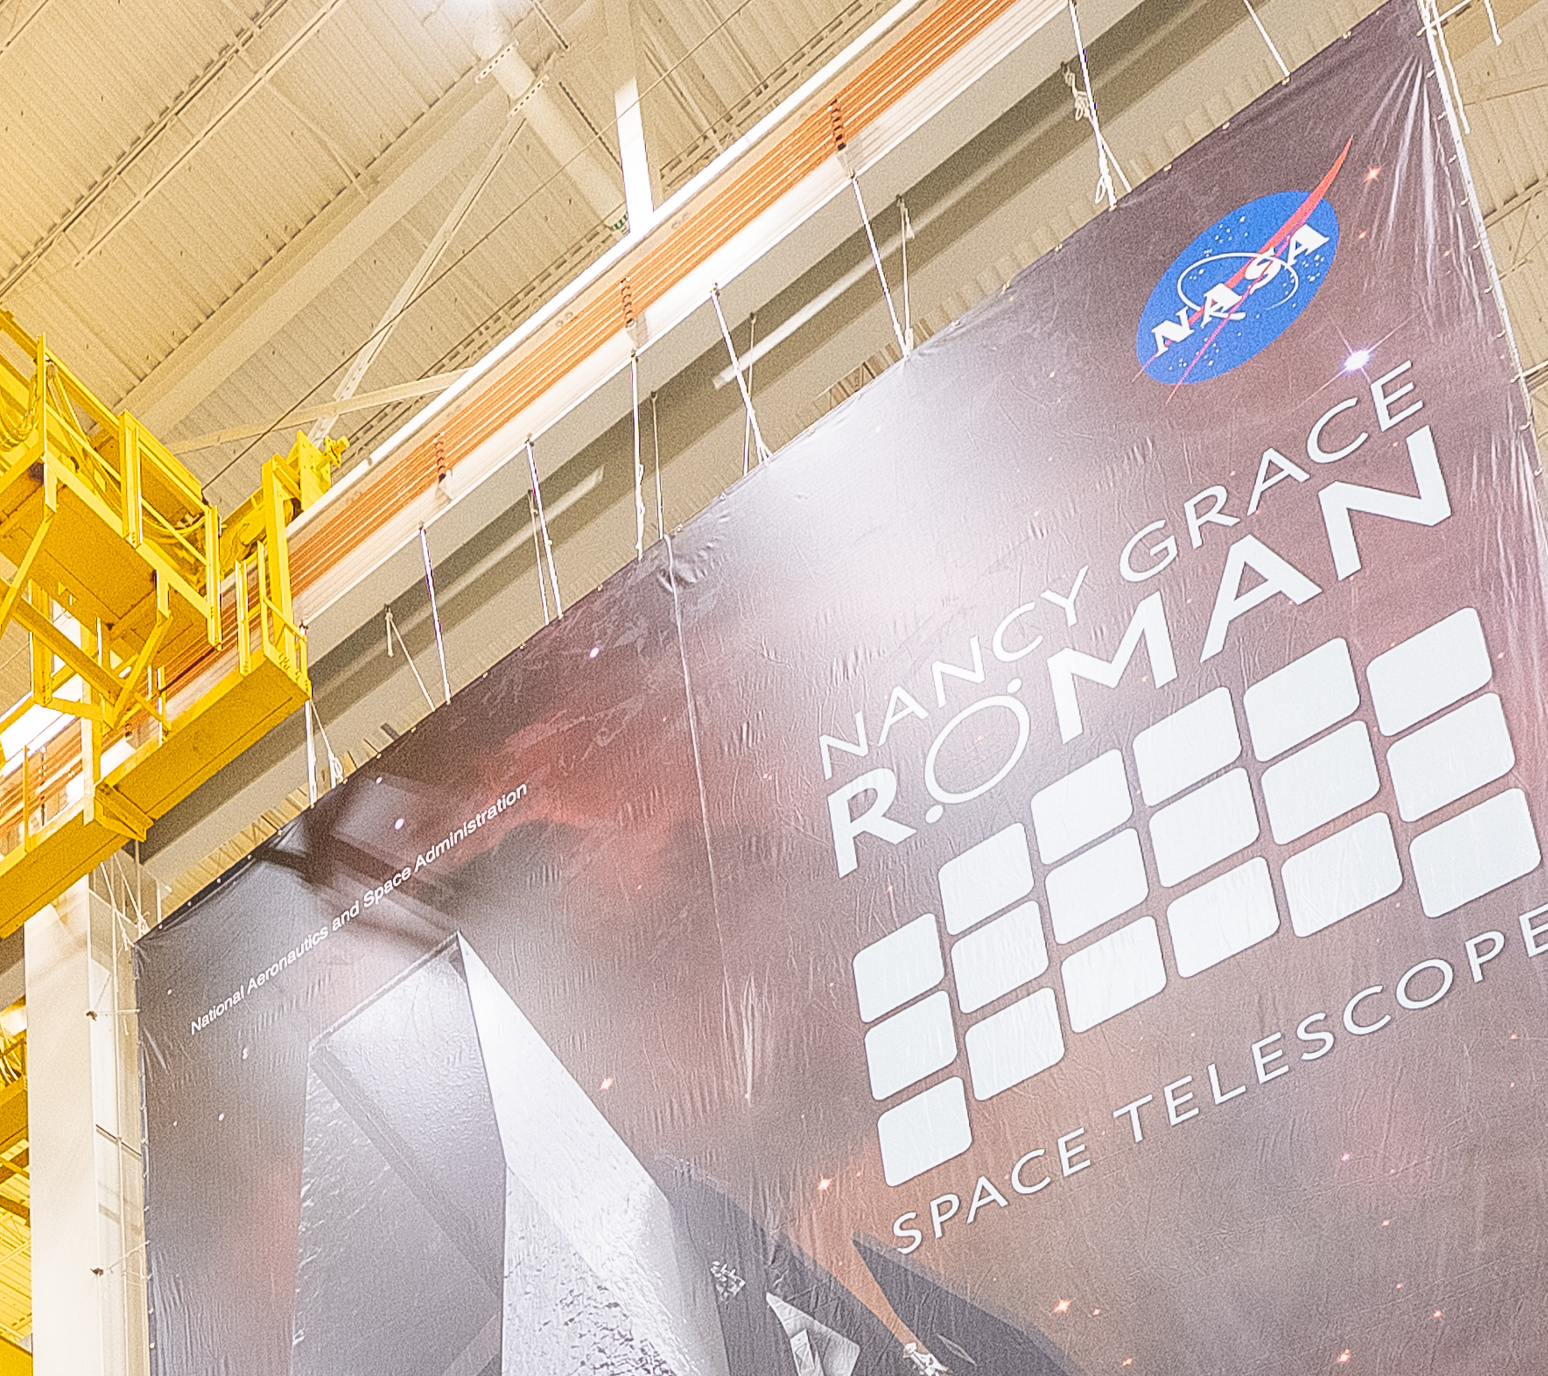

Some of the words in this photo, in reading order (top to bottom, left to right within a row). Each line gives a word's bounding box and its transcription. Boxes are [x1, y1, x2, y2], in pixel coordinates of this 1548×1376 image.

[1151, 224, 1331, 359] NASA
[818, 569, 1091, 781] NANCY
[1118, 361, 1427, 586] GRACE
[826, 425, 1453, 879] ROMAN
[189, 986, 245, 1036] National
[246, 929, 330, 995] Aeronautics
[331, 903, 360, 933] and
[363, 866, 412, 909] Space
[414, 782, 528, 872] Administration
[891, 1127, 1092, 1256] SPACE
